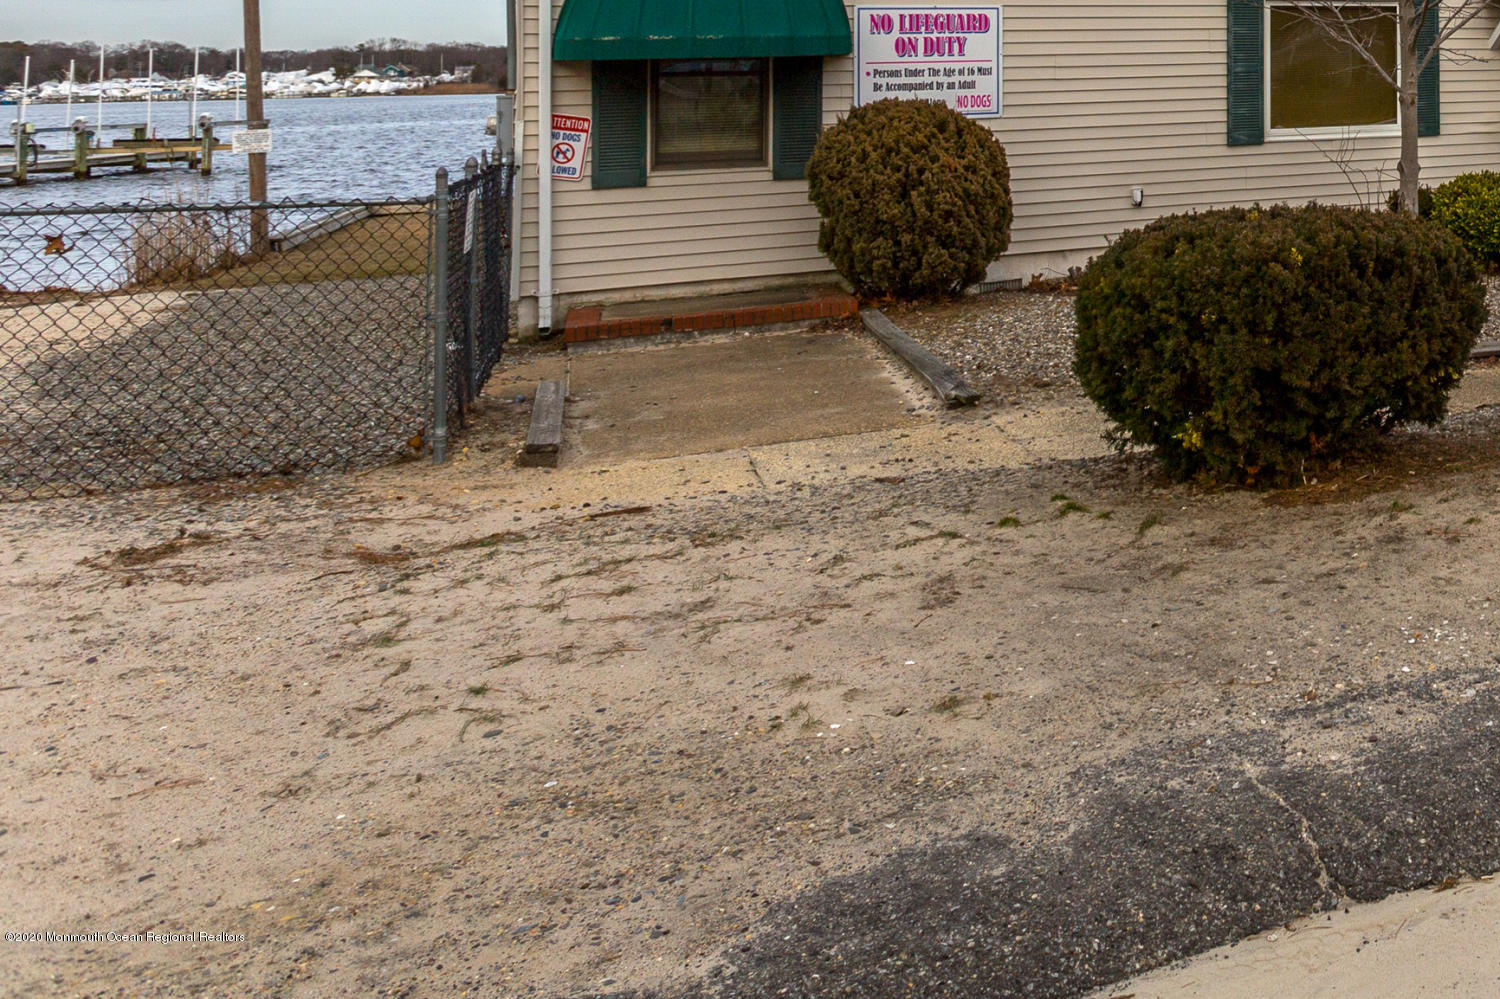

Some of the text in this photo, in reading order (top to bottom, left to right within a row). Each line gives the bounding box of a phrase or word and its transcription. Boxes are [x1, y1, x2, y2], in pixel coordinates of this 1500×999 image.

[869, 13, 991, 34] NO LIFEGUARD
[894, 36, 967, 57] ON DUTY
[873, 66, 992, 79] Persons Under The Age of 16 Must
[873, 80, 976, 92] Be Accompanied by an Adult
[957, 95, 969, 109] NO
[970, 94, 992, 108] DOGS
[553, 117, 589, 130] TTENTION
[551, 131, 581, 142] NO DOGS
[552, 165, 577, 175] LOWED
